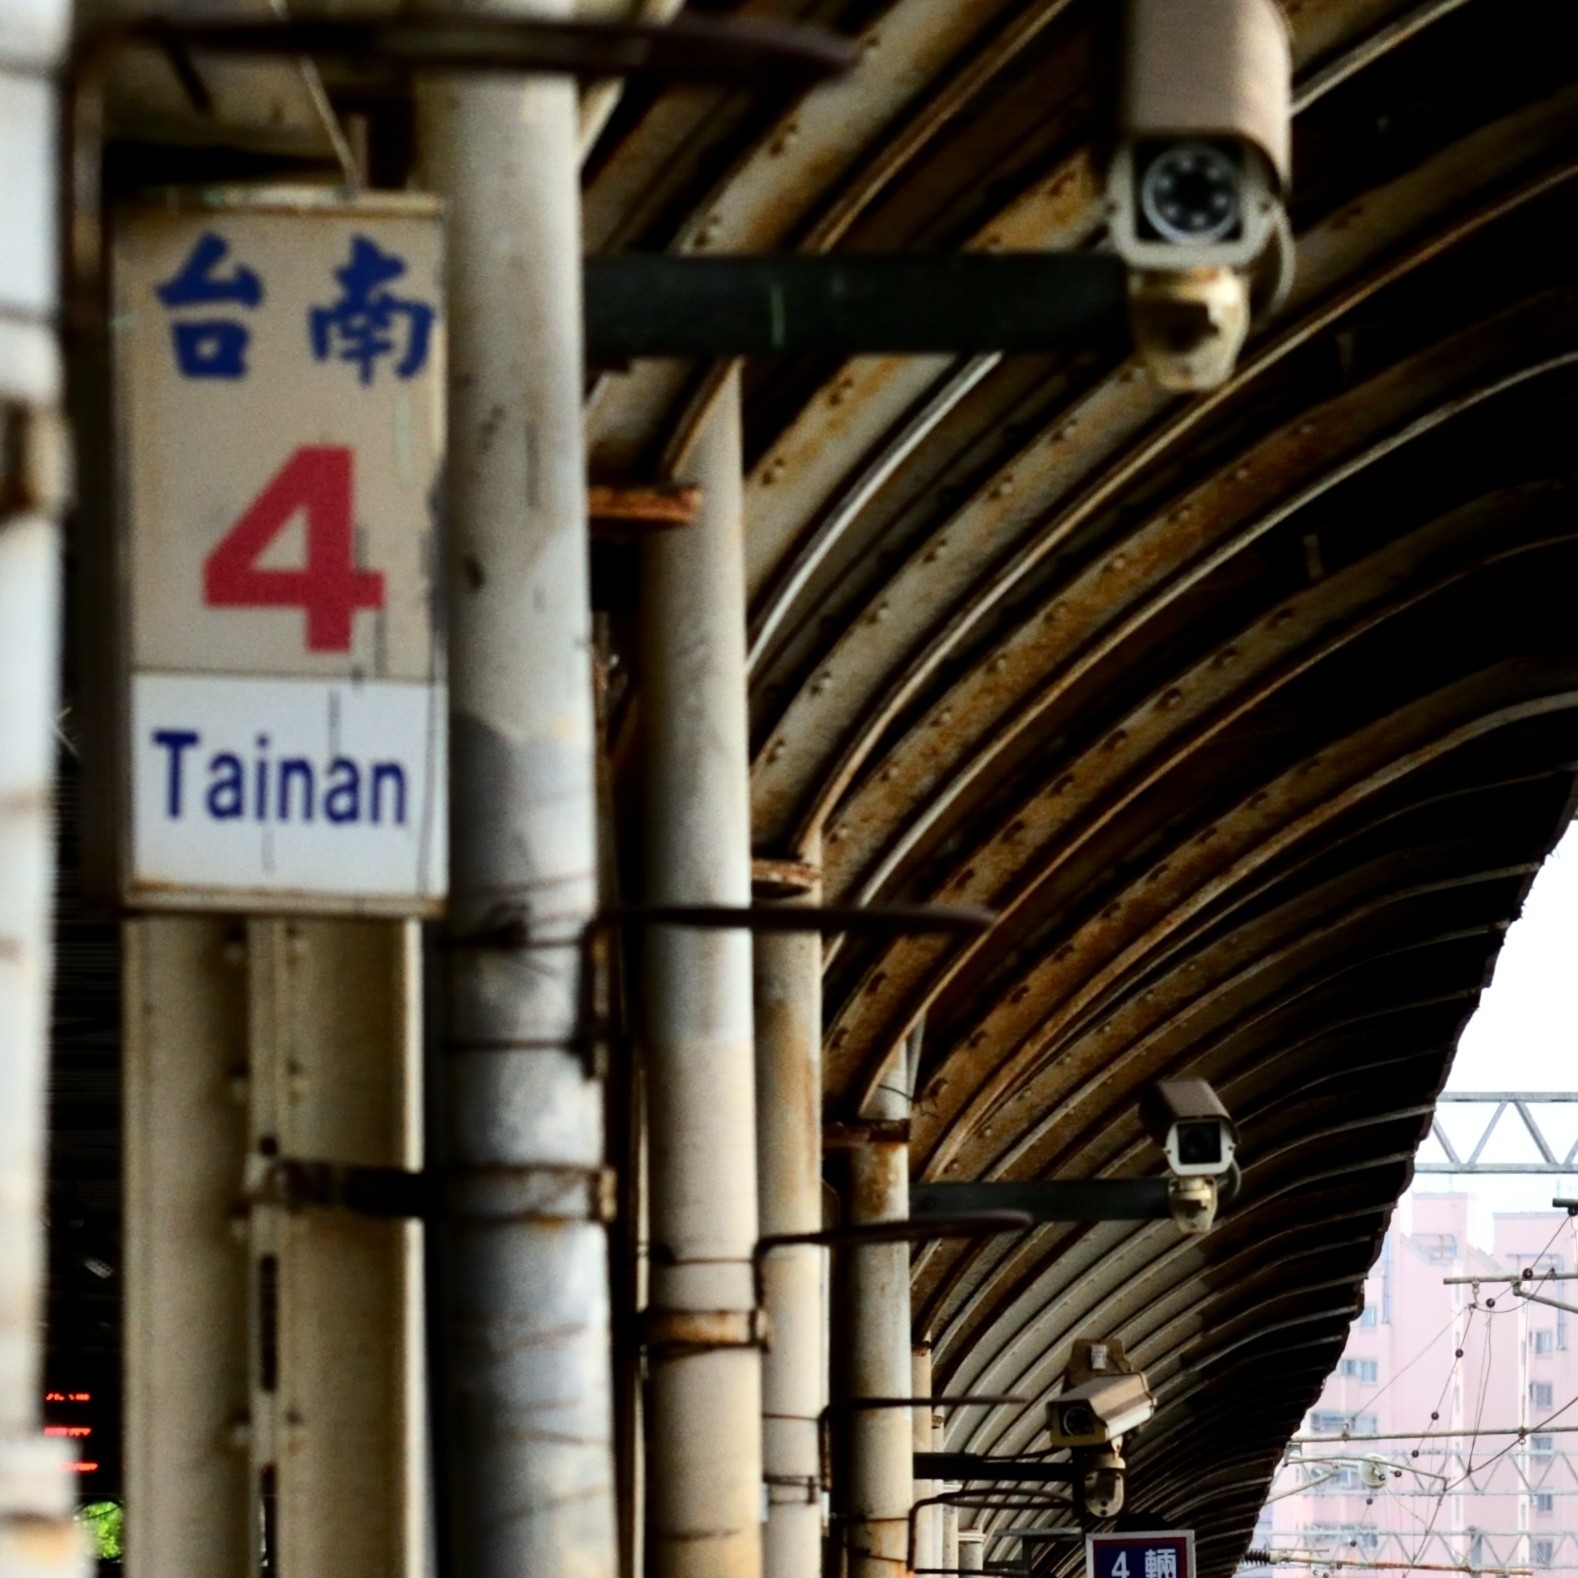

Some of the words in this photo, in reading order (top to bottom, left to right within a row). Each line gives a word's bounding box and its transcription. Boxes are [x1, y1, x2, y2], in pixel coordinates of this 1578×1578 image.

[154, 233, 436, 386] 台南
[203, 444, 387, 653] 4
[152, 730, 408, 826] Tainan
